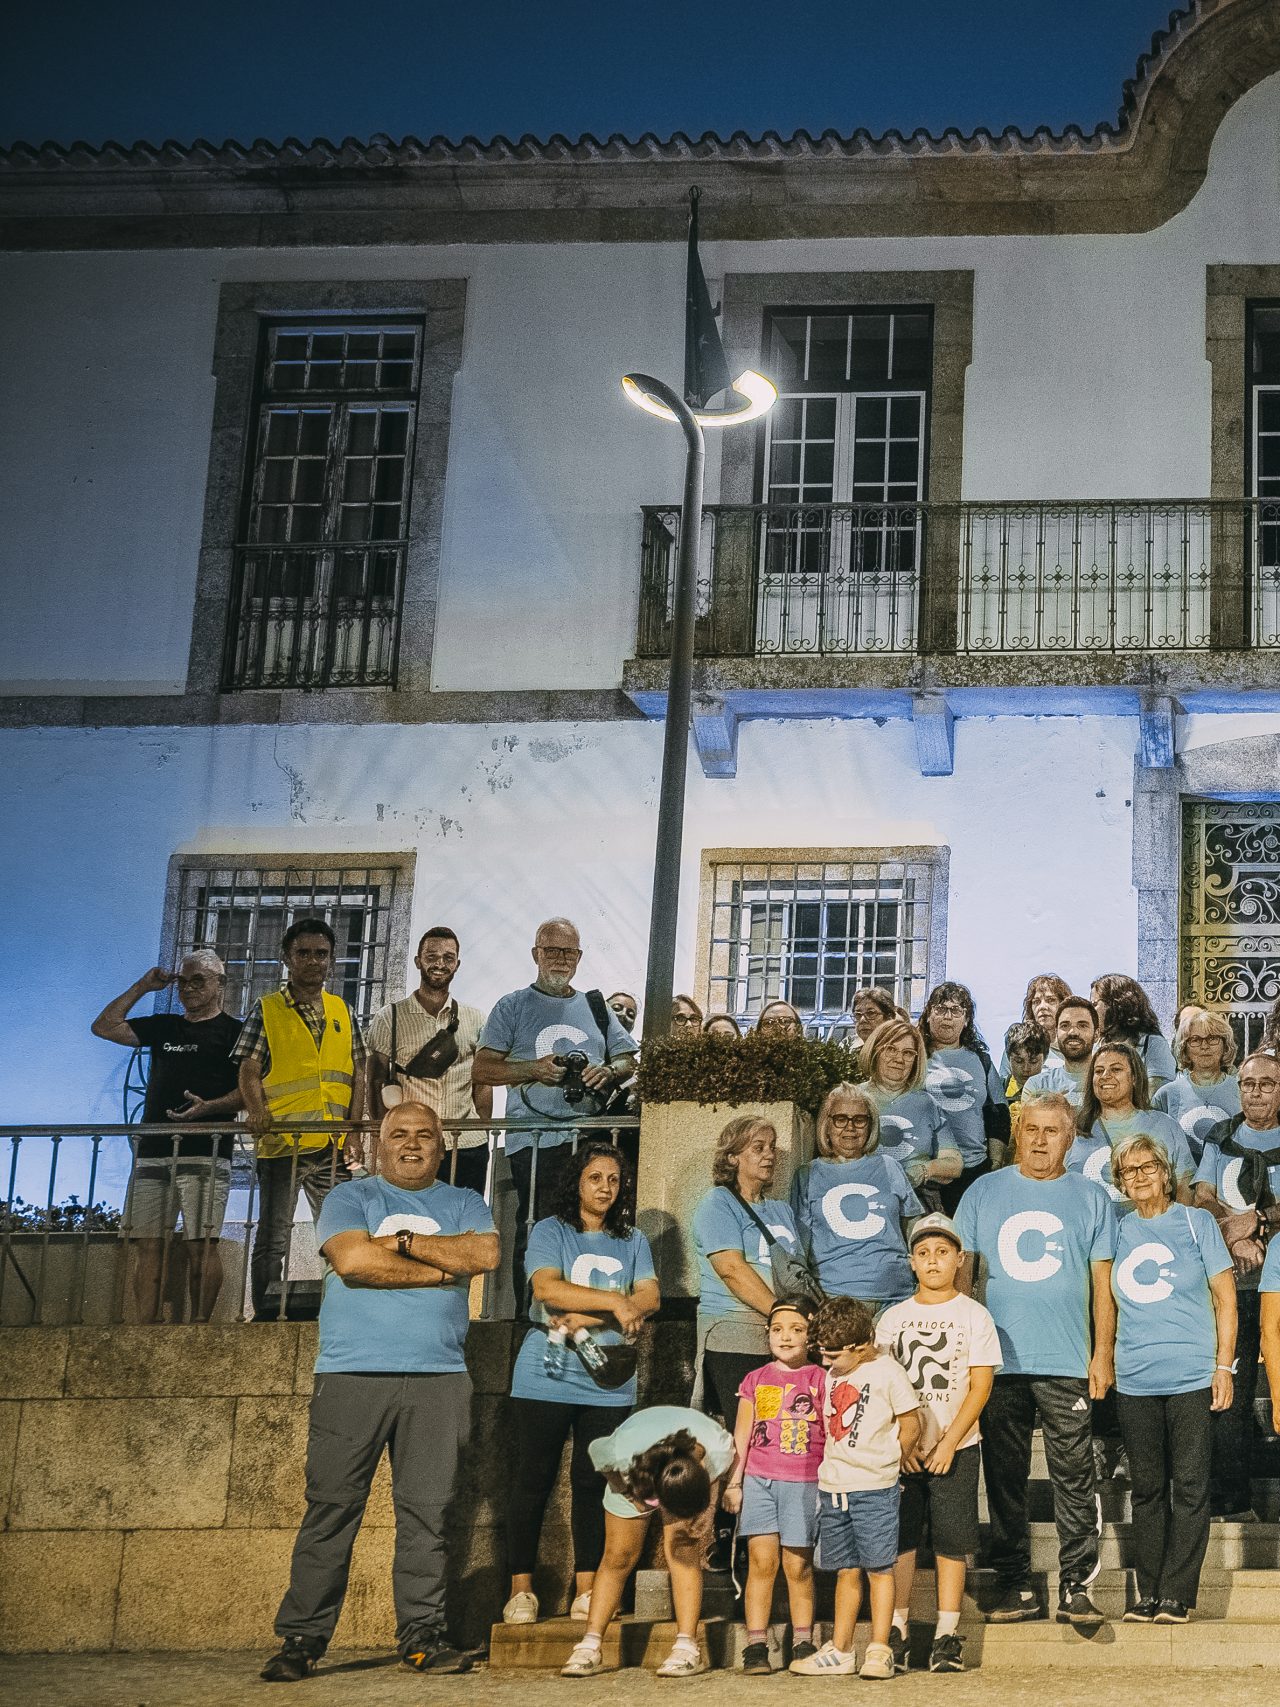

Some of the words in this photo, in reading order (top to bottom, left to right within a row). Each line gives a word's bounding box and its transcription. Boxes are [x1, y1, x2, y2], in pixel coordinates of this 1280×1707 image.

[822, 1183, 885, 1240] C
[998, 1211, 1064, 1282] C
[1117, 1243, 1175, 1304] C
[901, 1321, 955, 1330] CARIOCA
[951, 1332, 965, 1391] CREATIVE
[847, 1383, 871, 1448] AMAZING
